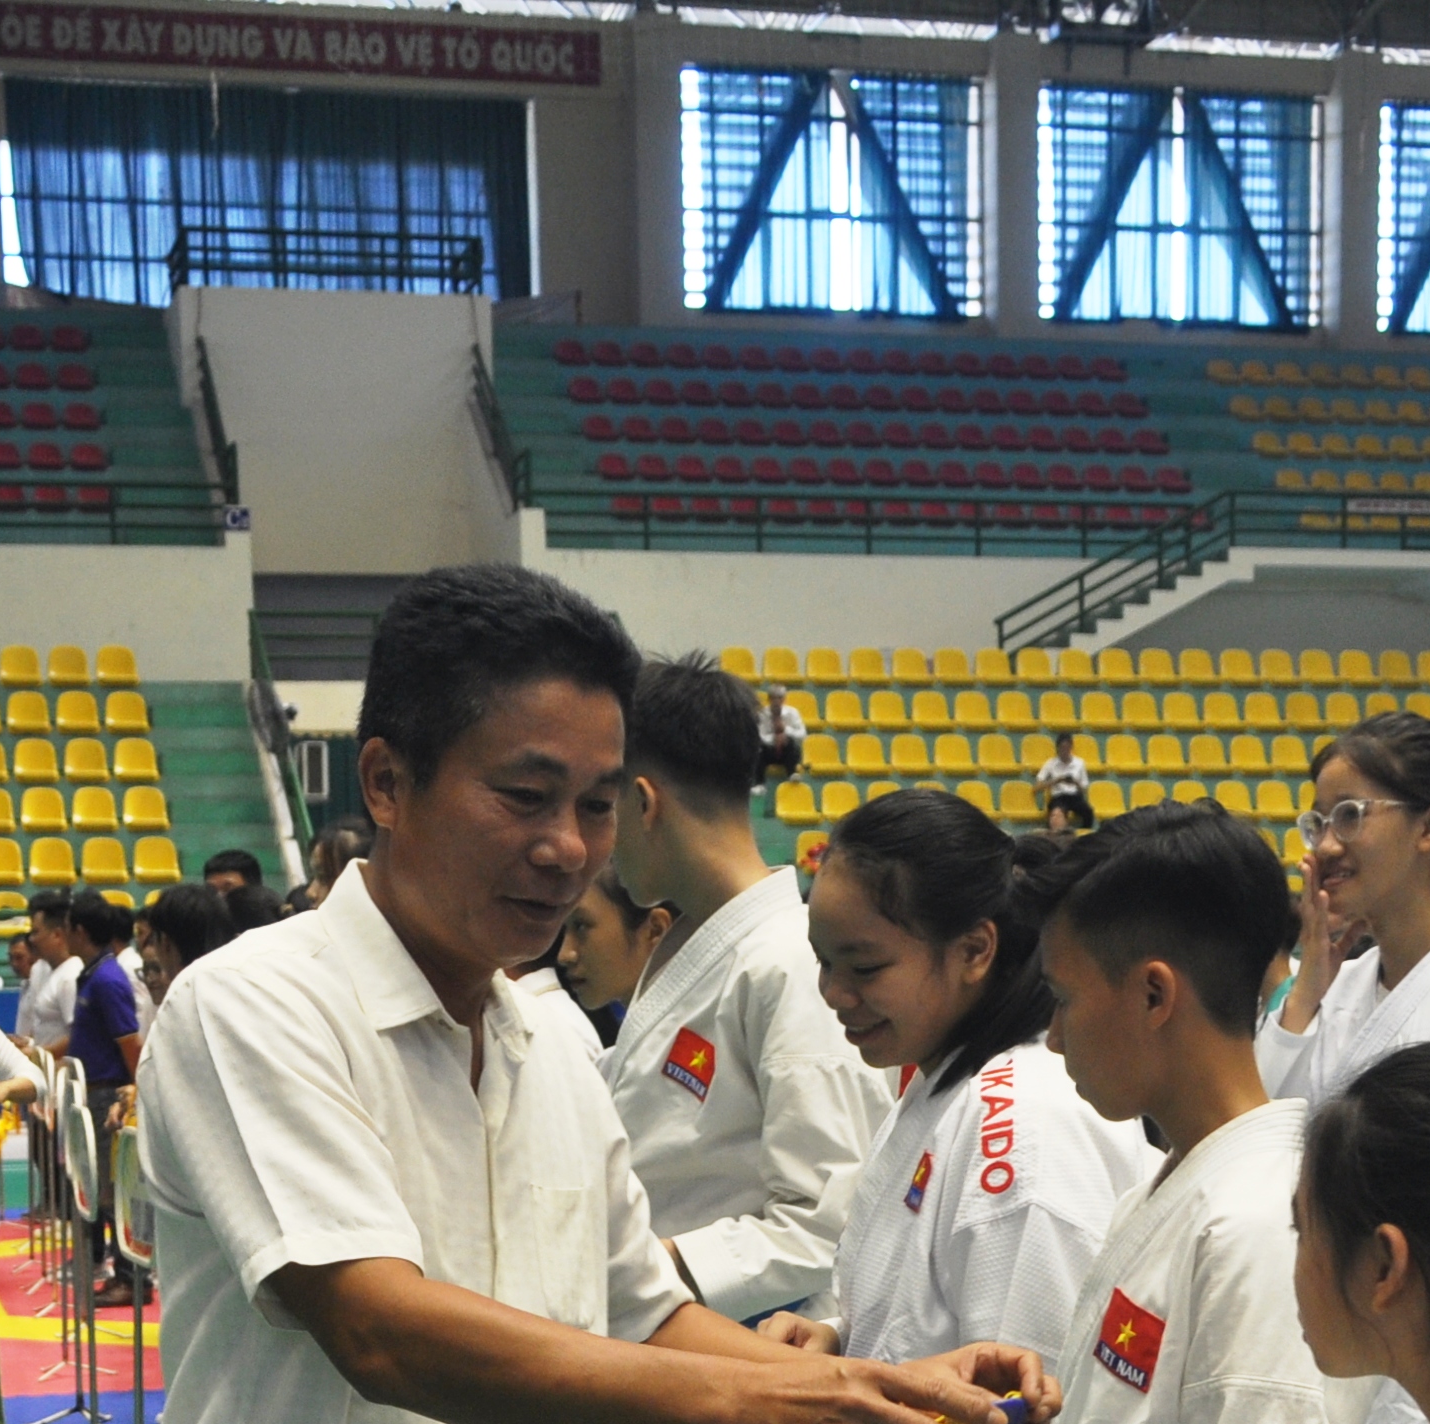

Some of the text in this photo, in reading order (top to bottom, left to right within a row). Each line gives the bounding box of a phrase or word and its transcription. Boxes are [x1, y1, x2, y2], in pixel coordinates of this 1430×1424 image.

[100, 14, 164, 55] XÂY
[172, 22, 264, 64] DỰNG
[272, 22, 316, 61] VÀ
[1116, 1358, 1145, 1386] NAM
